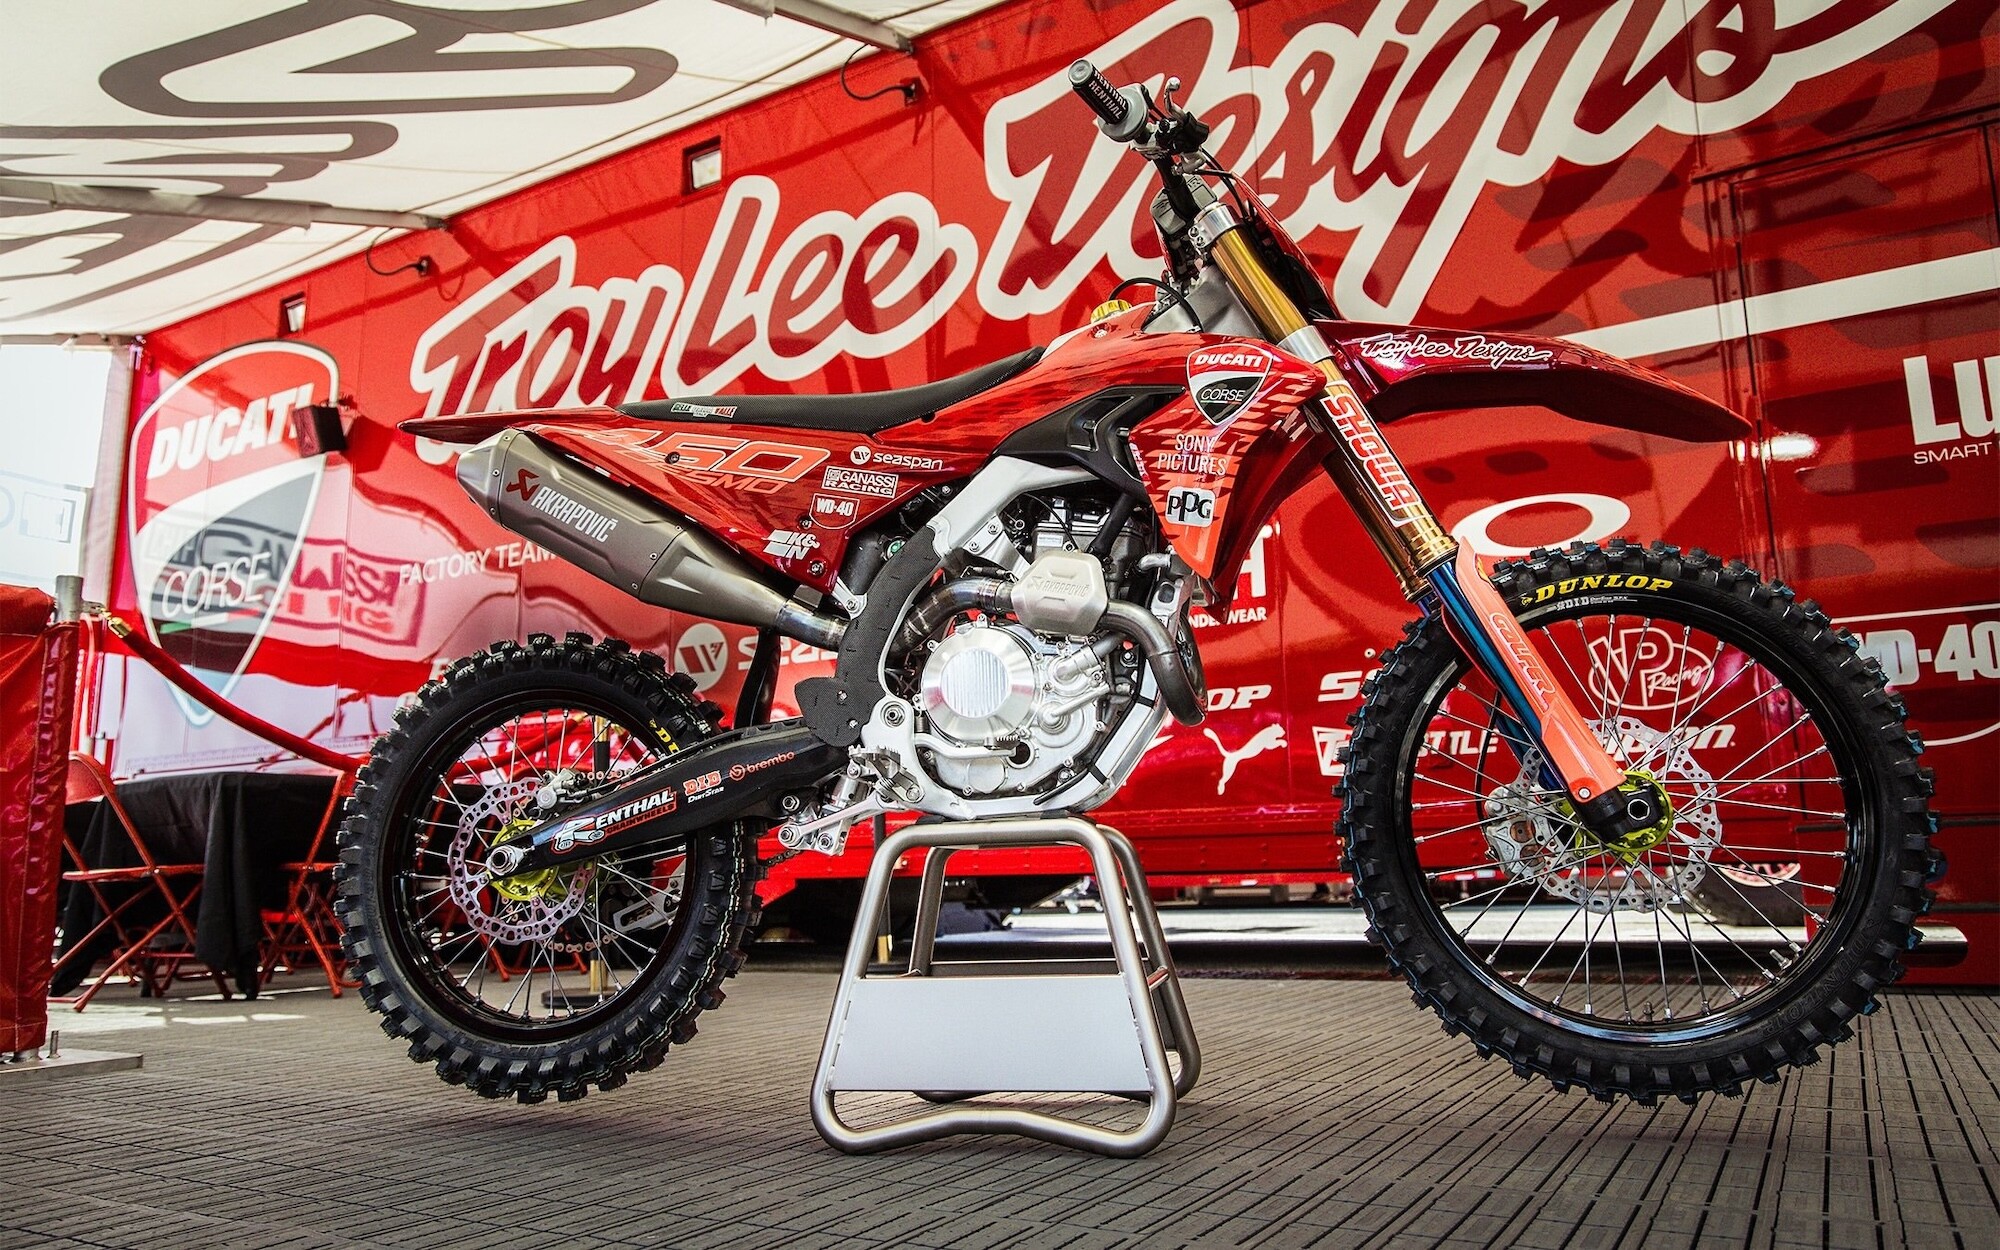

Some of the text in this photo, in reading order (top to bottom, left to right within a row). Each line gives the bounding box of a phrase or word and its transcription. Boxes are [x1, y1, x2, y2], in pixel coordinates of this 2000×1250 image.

[1088, 80, 1123, 119] RENTHAL
[409, 235, 683, 465] Troy
[661, 174, 979, 398] Lee
[1194, 353, 1264, 368] DUCATI
[1407, 334, 1452, 358] Lee
[1453, 335, 1553, 370] Designs
[1200, 389, 1246, 402] CORSE
[146, 382, 315, 480] DUCATI
[1175, 433, 1216, 452] SONY
[873, 452, 943, 470] seaspan
[1157, 453, 1227, 475] PICTURES
[1320, 393, 1422, 511] SHOWA
[1913, 441, 1993, 465] SMART
[825, 480, 893, 496] RACING
[840, 470, 896, 488] GANASSI
[530, 486, 618, 543] AKRAPOVIČ
[815, 497, 854, 517] WD-40
[1166, 491, 1213, 522] PPG
[400, 548, 491, 586] FACTORY
[161, 552, 272, 618] CORSE
[1535, 574, 1673, 603] DUNLOP
[1647, 665, 1711, 697] Racing
[746, 751, 796, 773] brembo
[555, 789, 675, 851] RENTHAL
